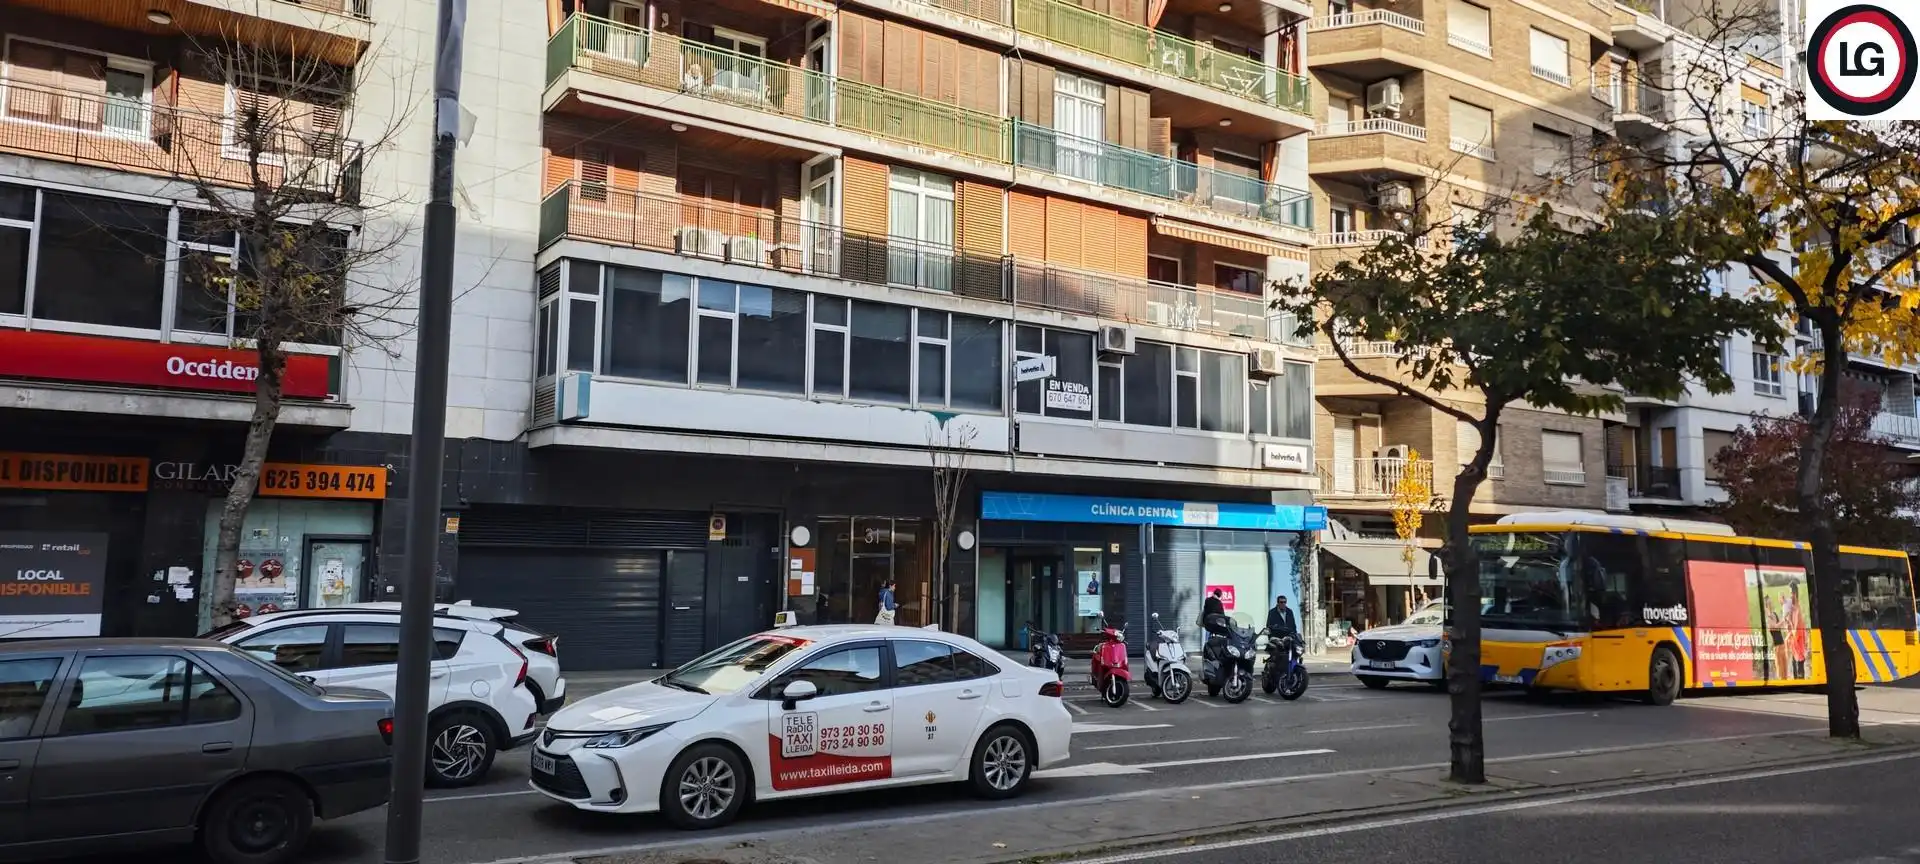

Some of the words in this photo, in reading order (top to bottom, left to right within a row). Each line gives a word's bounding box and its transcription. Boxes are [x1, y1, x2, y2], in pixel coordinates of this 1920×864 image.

[166, 357, 259, 380] Occiden
[1021, 365, 1040, 374] helvetia
[1050, 380, 1060, 390] EN
[1062, 382, 1089, 394] VENDA
[1048, 392, 1061, 402] 670
[1271, 452, 1295, 462] helvetia
[20, 460, 141, 484] DISPONIBLE
[265, 469, 300, 490] 625
[306, 471, 341, 492] 394
[346, 472, 376, 492] 474
[1091, 503, 1135, 517] CLÍNICA
[1138, 506, 1179, 518] DENTAL
[865, 528, 879, 544] 31
[17, 570, 64, 580] LOCAL
[1643, 603, 1687, 621] moventis
[786, 716, 813, 725] TELE
[820, 727, 839, 739] 973
[843, 726, 855, 737] 20
[857, 725, 870, 736] 30
[872, 723, 885, 734] 50
[787, 733, 813, 745] TAXI
[820, 739, 839, 750] 973
[842, 738, 855, 748] 24
[857, 736, 869, 747] 90
[872, 735, 884, 745] 90
[786, 745, 814, 753] LLEIDA
[780, 762, 884, 781] www.taxilleida.com
